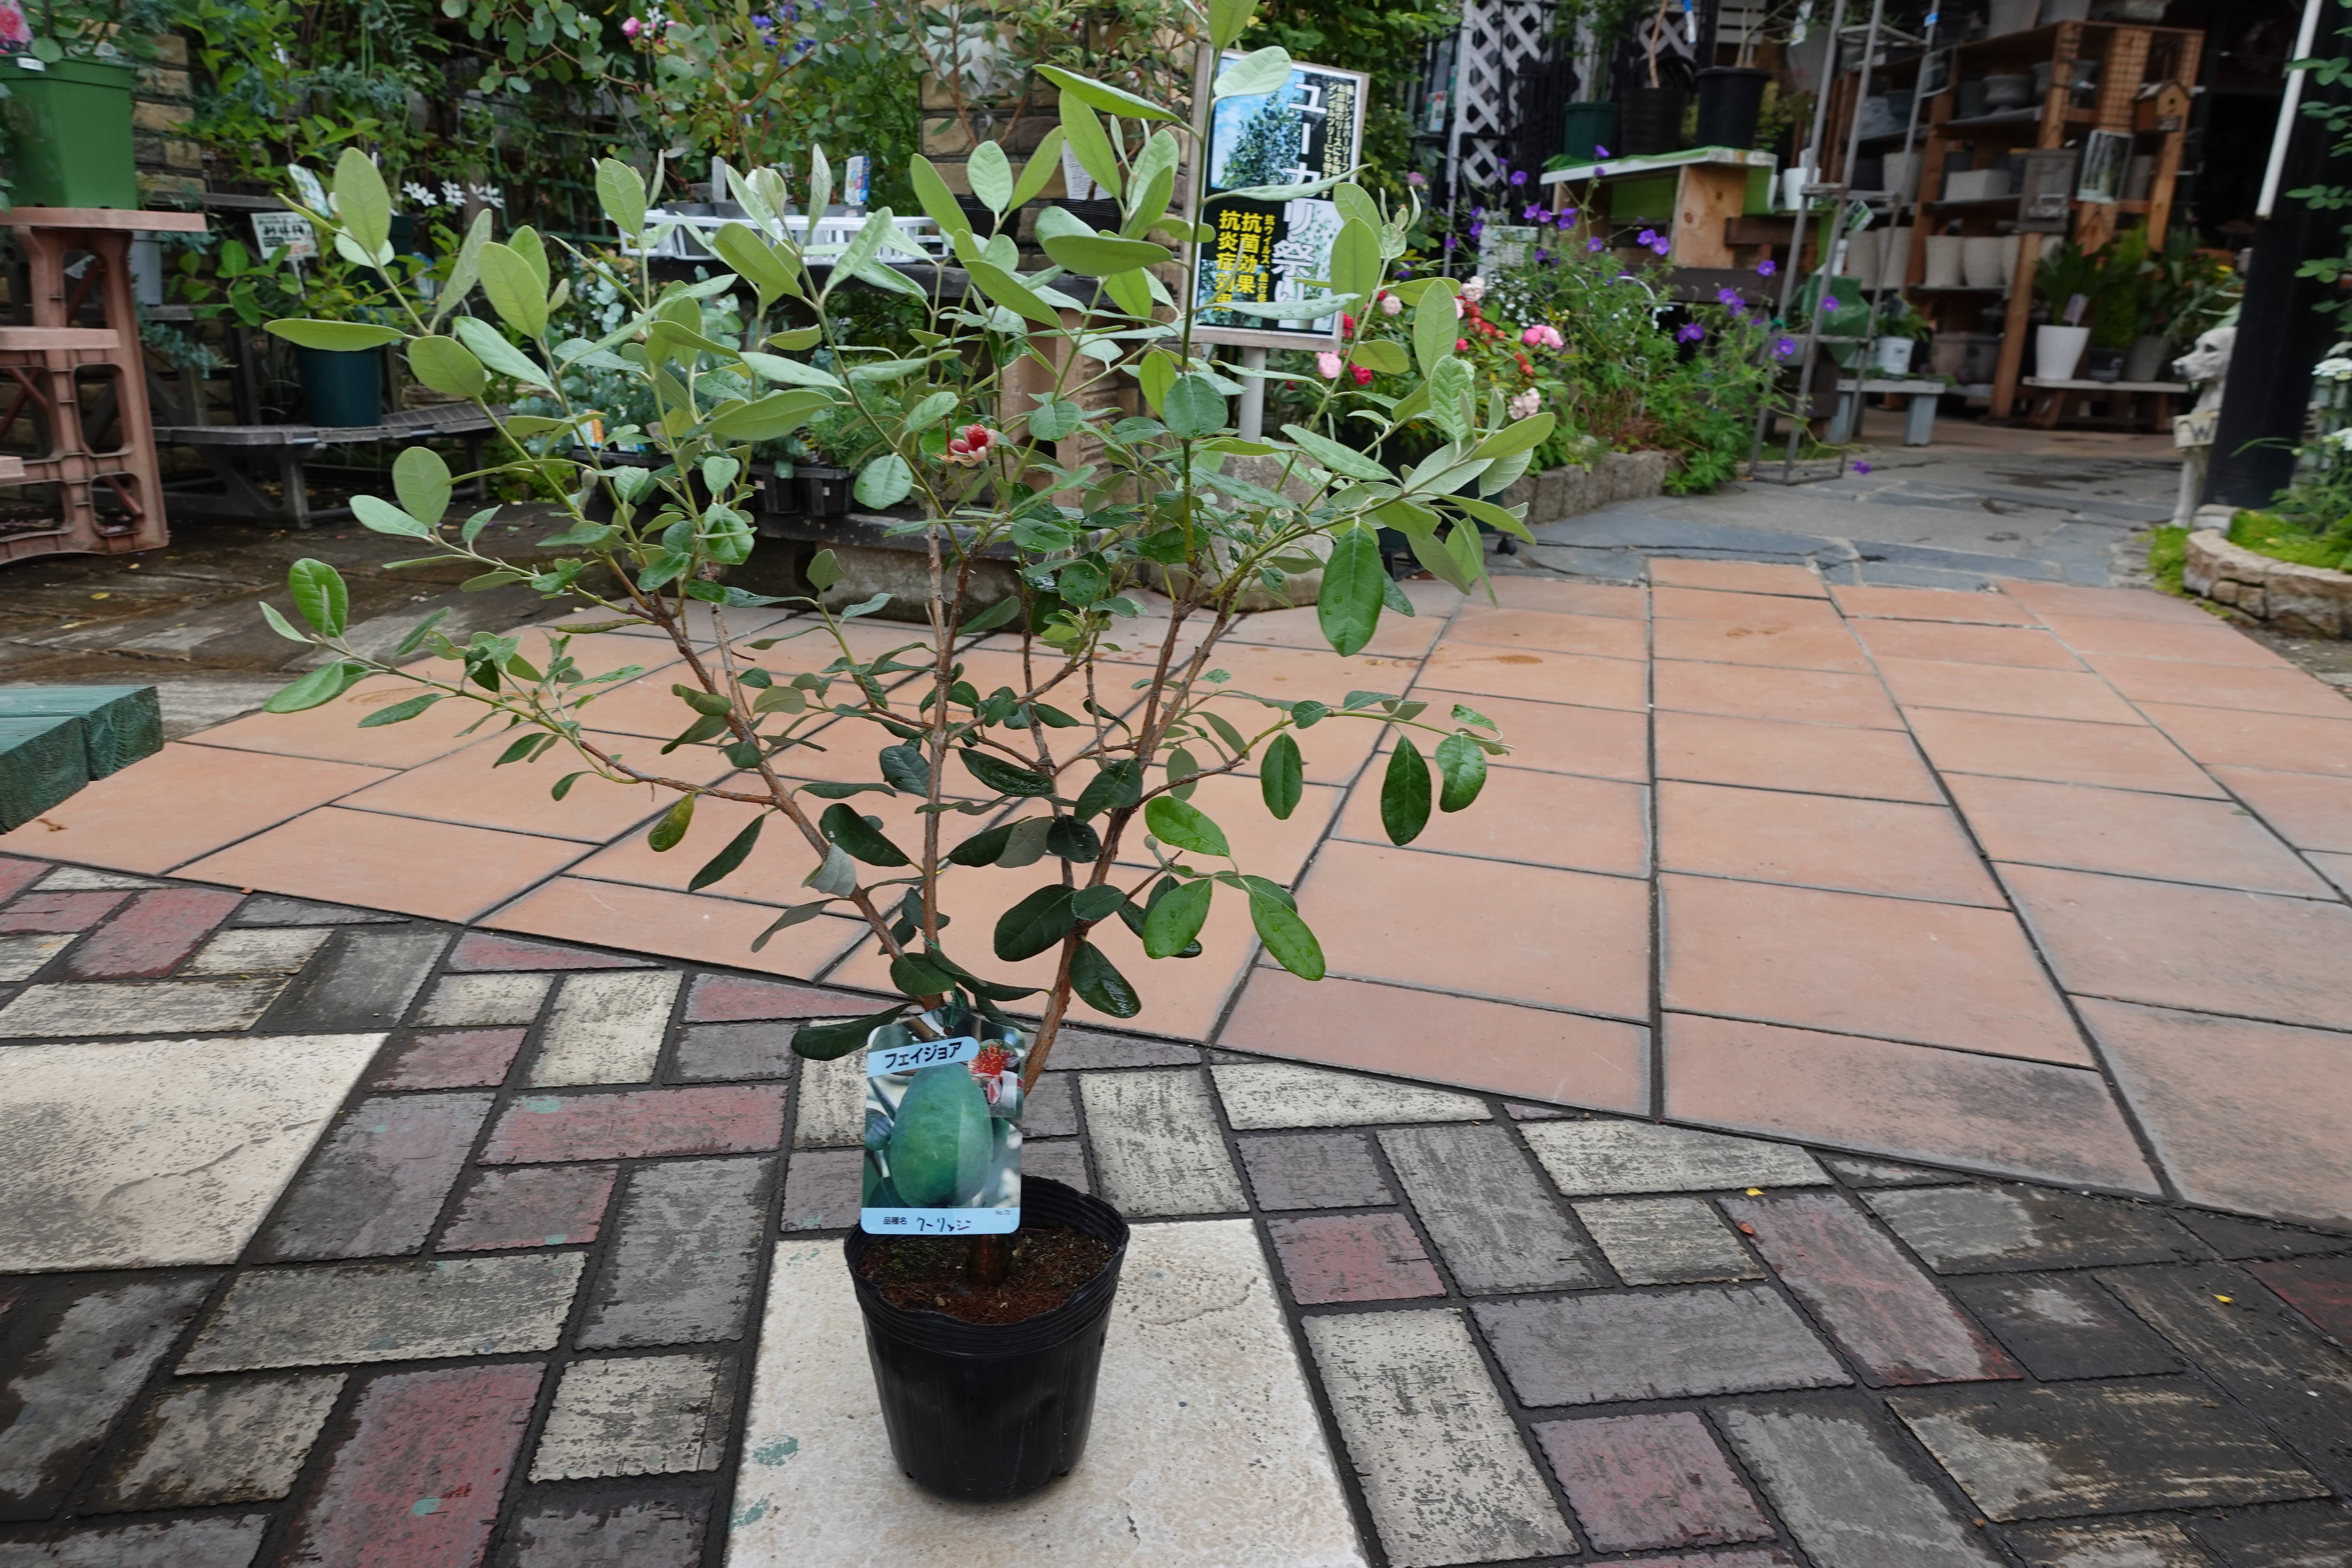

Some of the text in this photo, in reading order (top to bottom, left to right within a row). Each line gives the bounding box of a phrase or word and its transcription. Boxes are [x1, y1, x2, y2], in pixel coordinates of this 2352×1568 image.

[1236, 213, 1263, 294] 抗菌効果
[884, 1042, 962, 1069] フェイジョア
